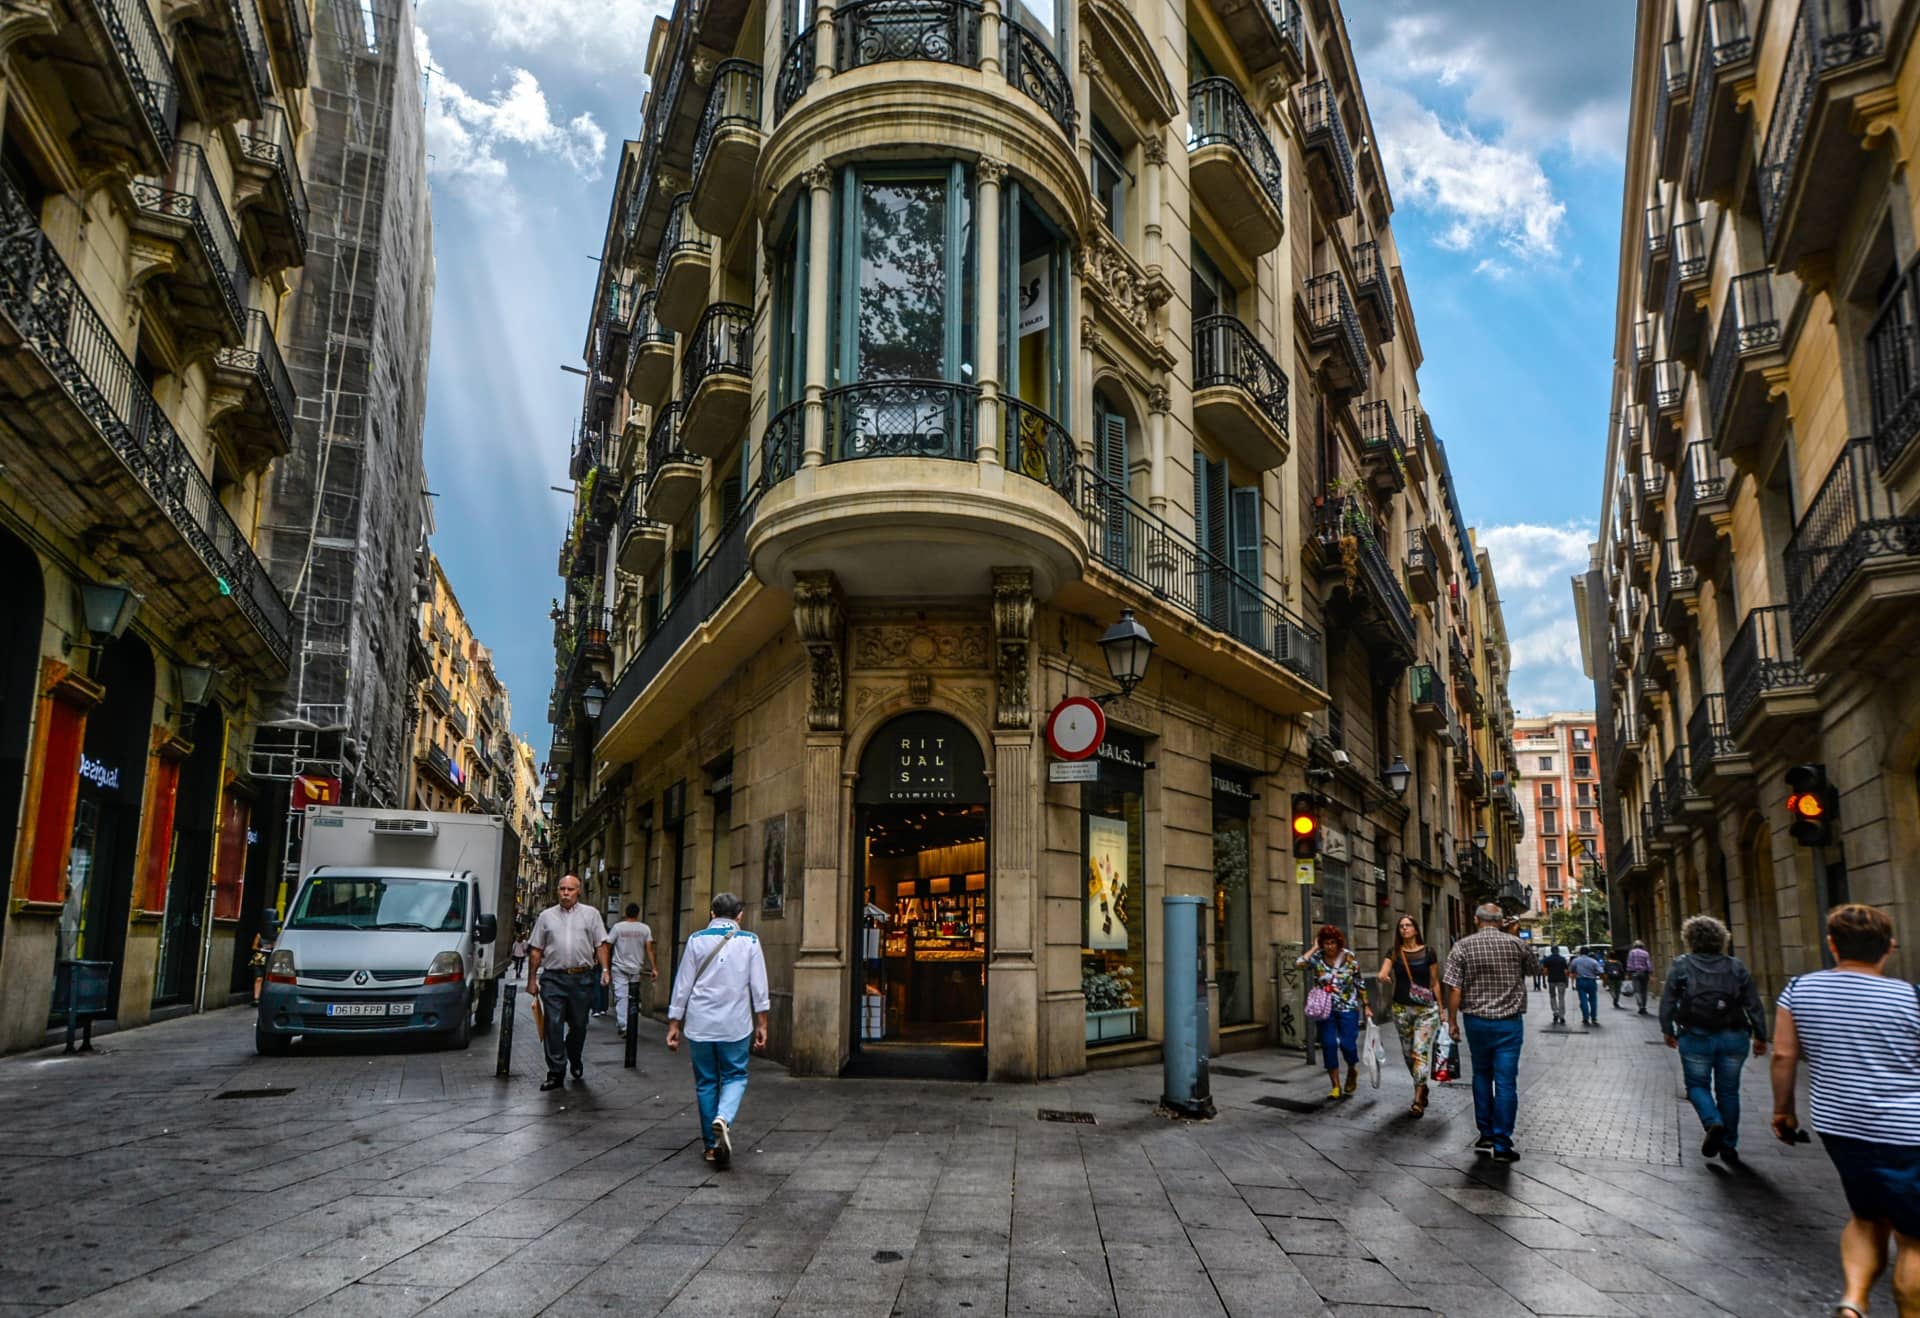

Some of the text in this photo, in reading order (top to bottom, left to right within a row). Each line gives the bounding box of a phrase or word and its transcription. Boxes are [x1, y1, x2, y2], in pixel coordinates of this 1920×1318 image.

[901, 738, 945, 749] RIT
[901, 755, 944, 766] UAL
[335, 1005, 361, 1015] 0619
